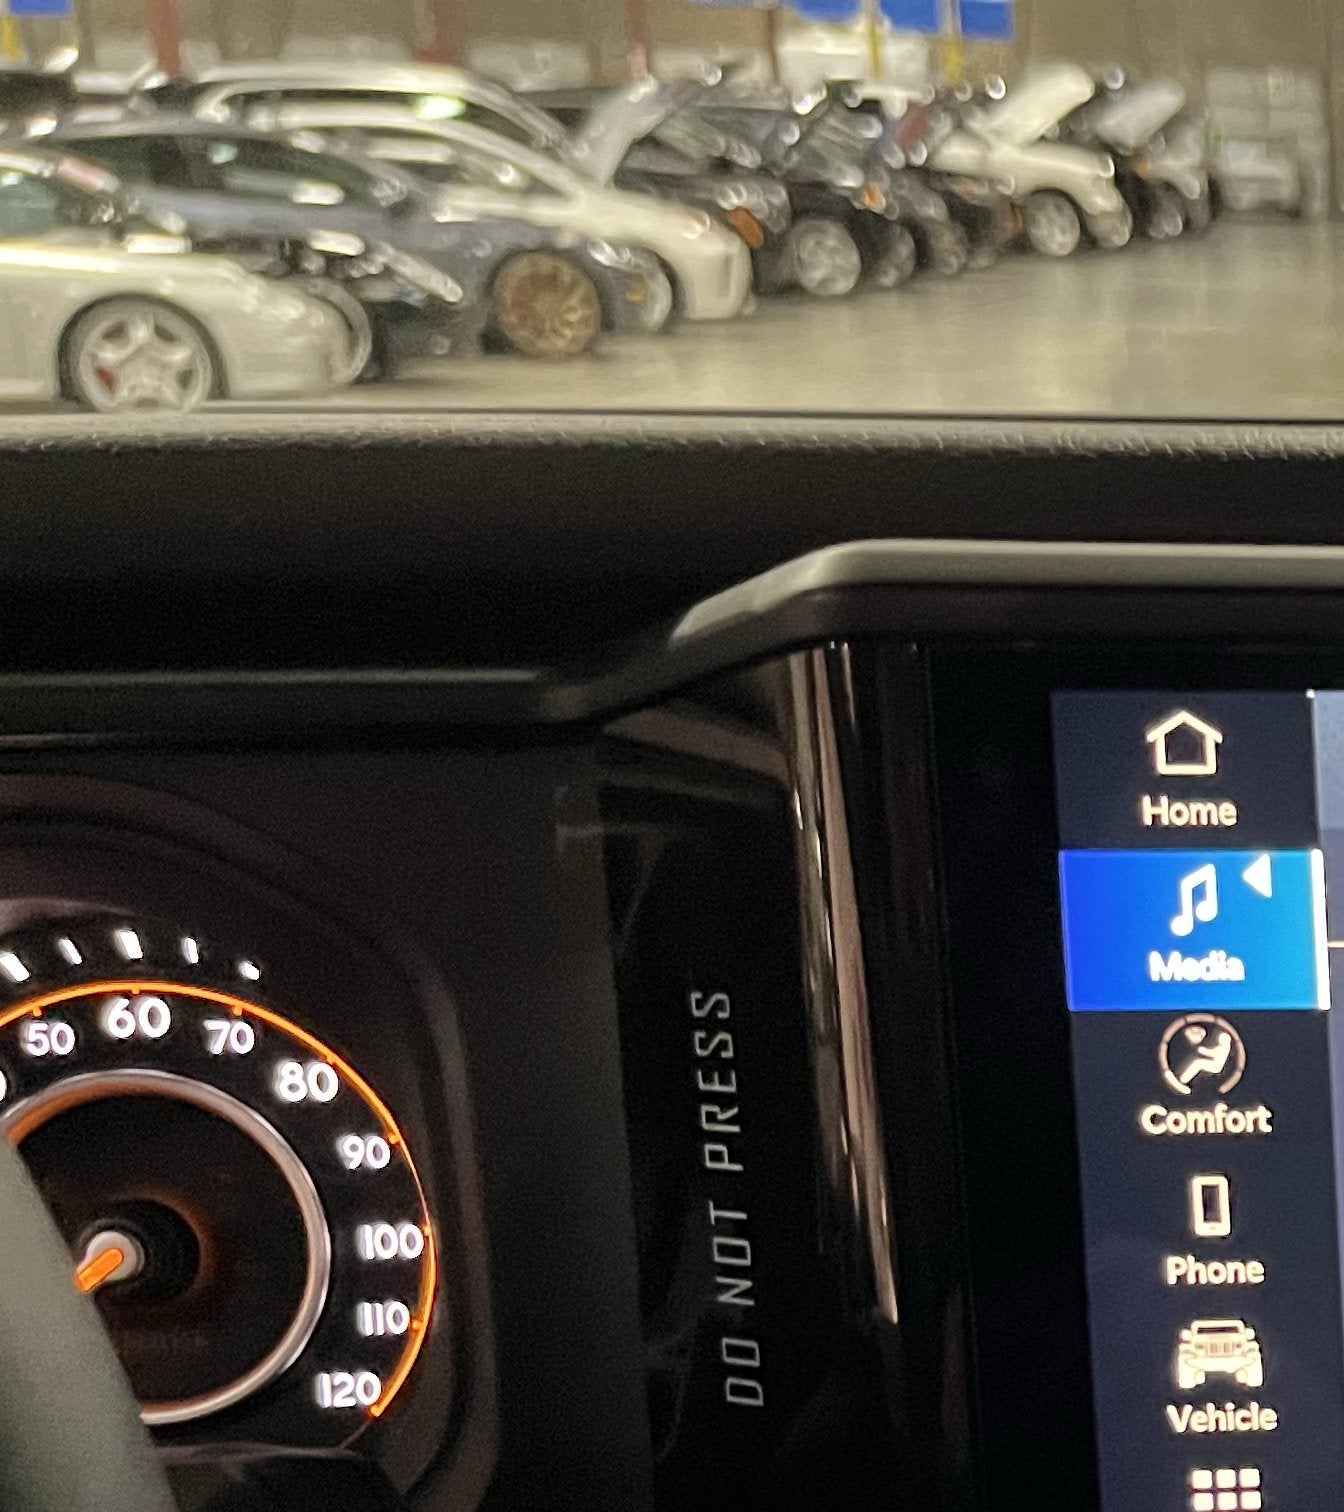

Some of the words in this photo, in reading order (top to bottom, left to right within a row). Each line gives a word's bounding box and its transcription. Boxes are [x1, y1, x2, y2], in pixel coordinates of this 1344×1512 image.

[1142, 795, 1237, 827] Home
[1149, 951, 1245, 982] Media
[106, 997, 171, 1038] 60
[24, 1021, 76, 1056] 50
[205, 1020, 255, 1054] 70
[276, 1060, 339, 1102] 80
[690, 991, 744, 1172] PRESS
[1140, 1103, 1273, 1135] Comfort
[339, 1134, 391, 1169] 90
[360, 1224, 424, 1259] 100
[708, 1200, 756, 1306] NOT
[1166, 1254, 1265, 1285] Phone
[359, 1302, 409, 1337] 110
[721, 1336, 764, 1407] DO
[318, 1372, 381, 1408] 120
[1166, 1402, 1278, 1434] Vehicle
